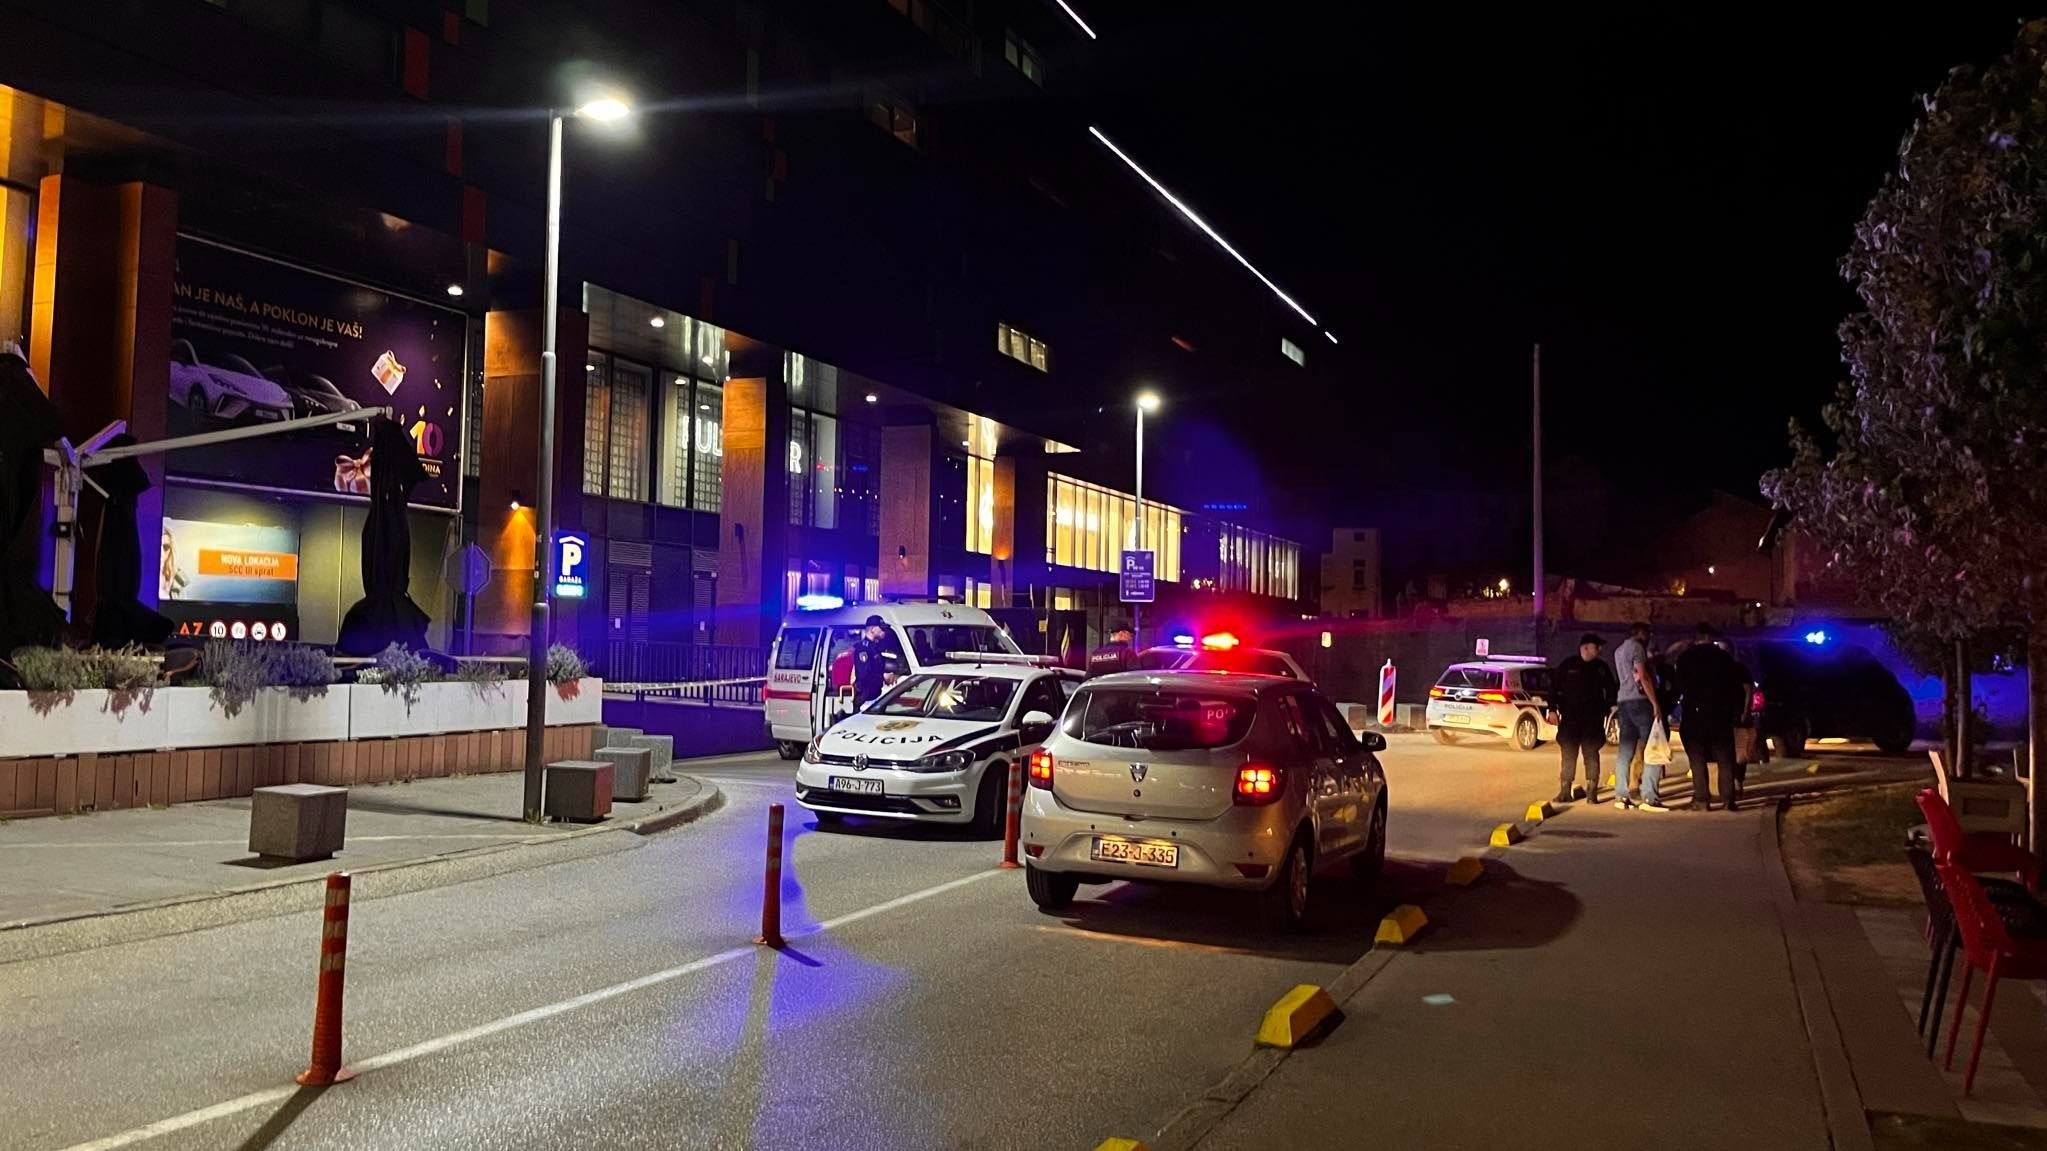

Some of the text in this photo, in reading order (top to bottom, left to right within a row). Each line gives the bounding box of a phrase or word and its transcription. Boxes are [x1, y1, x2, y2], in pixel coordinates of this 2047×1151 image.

[196, 287, 212, 303] JE
[249, 301, 260, 315] A
[262, 302, 319, 329] POKLON
[320, 316, 335, 333] JE
[336, 320, 364, 340] VAŠ!
[410, 420, 444, 456] 10
[789, 440, 802, 474] R
[220, 553, 280, 567] NOVA LOKACIJA
[562, 543, 582, 576] P
[1126, 559, 1136, 571] P
[214, 626, 224, 635] 10
[774, 672, 801, 684] SARAJEVO
[831, 729, 943, 745] POLICIJA
[1101, 842, 1175, 863] E23-J-335
